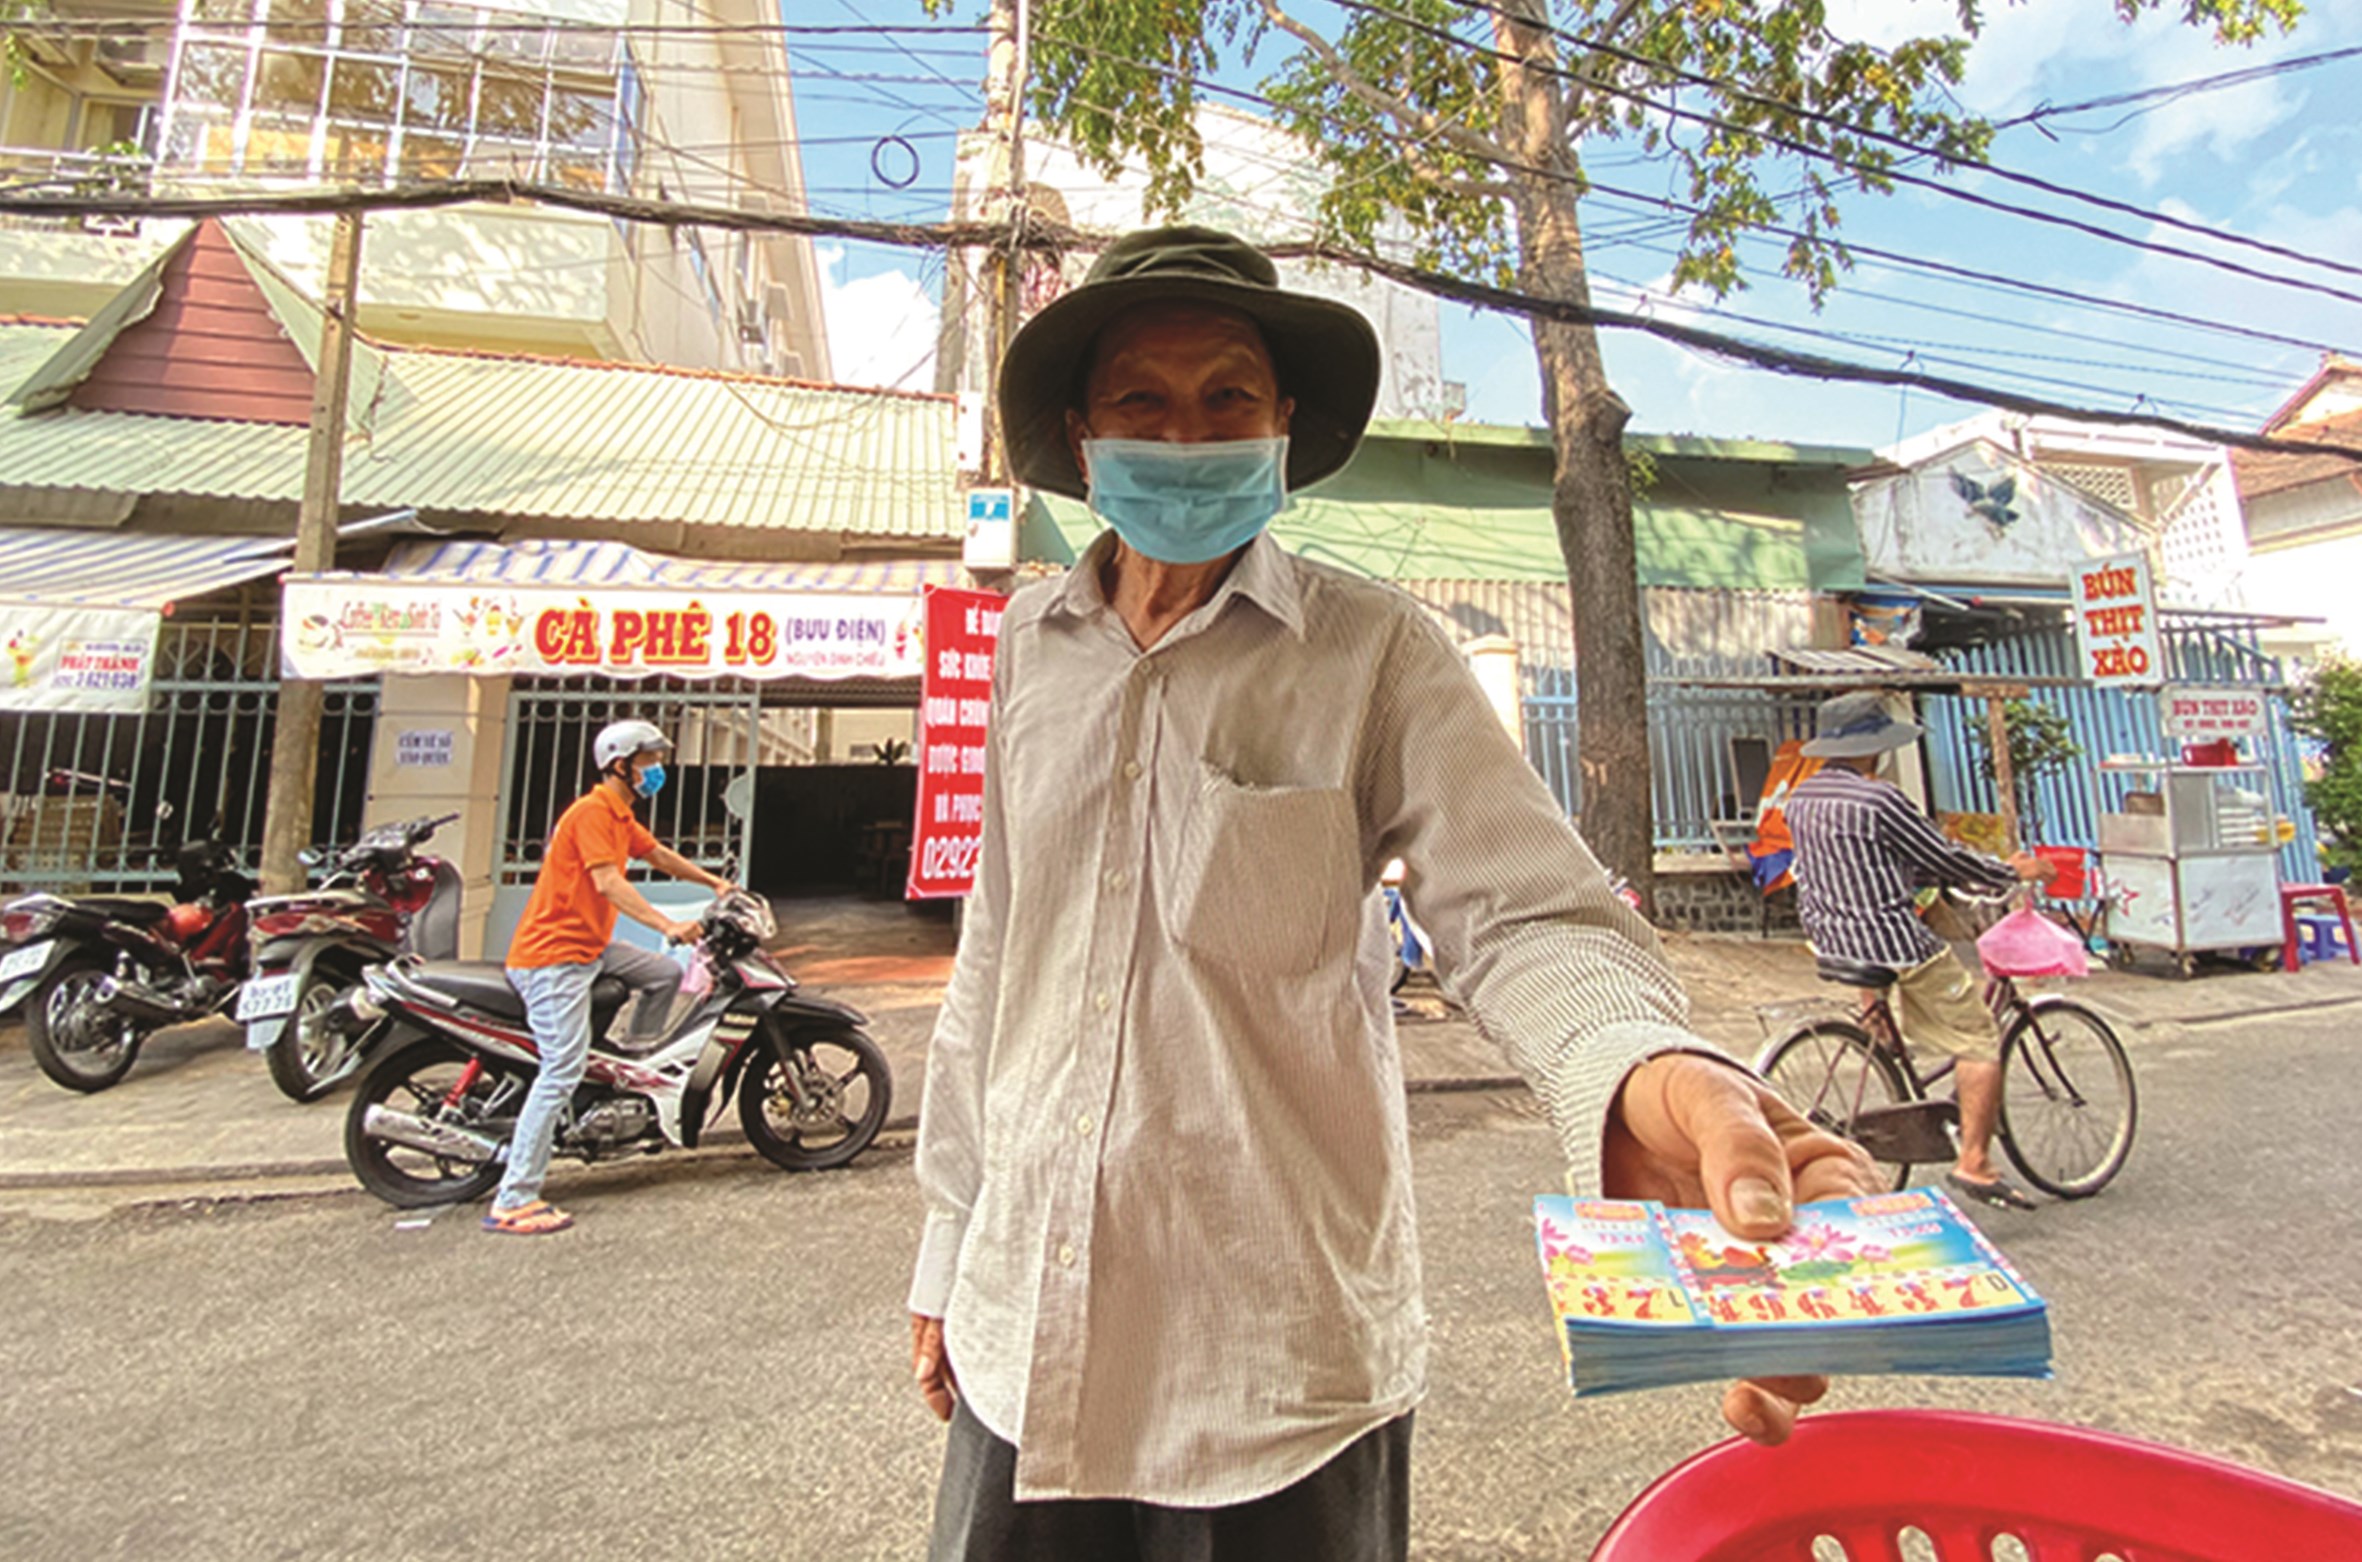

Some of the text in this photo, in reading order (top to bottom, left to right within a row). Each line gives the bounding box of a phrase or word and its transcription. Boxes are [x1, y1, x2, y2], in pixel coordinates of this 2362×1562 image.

[2081, 562, 2137, 601] BÚN
[535, 596, 778, 667] CÀ PHÊ 18
[2084, 603, 2146, 642] THỊT
[2091, 639, 2149, 677] XÀO
